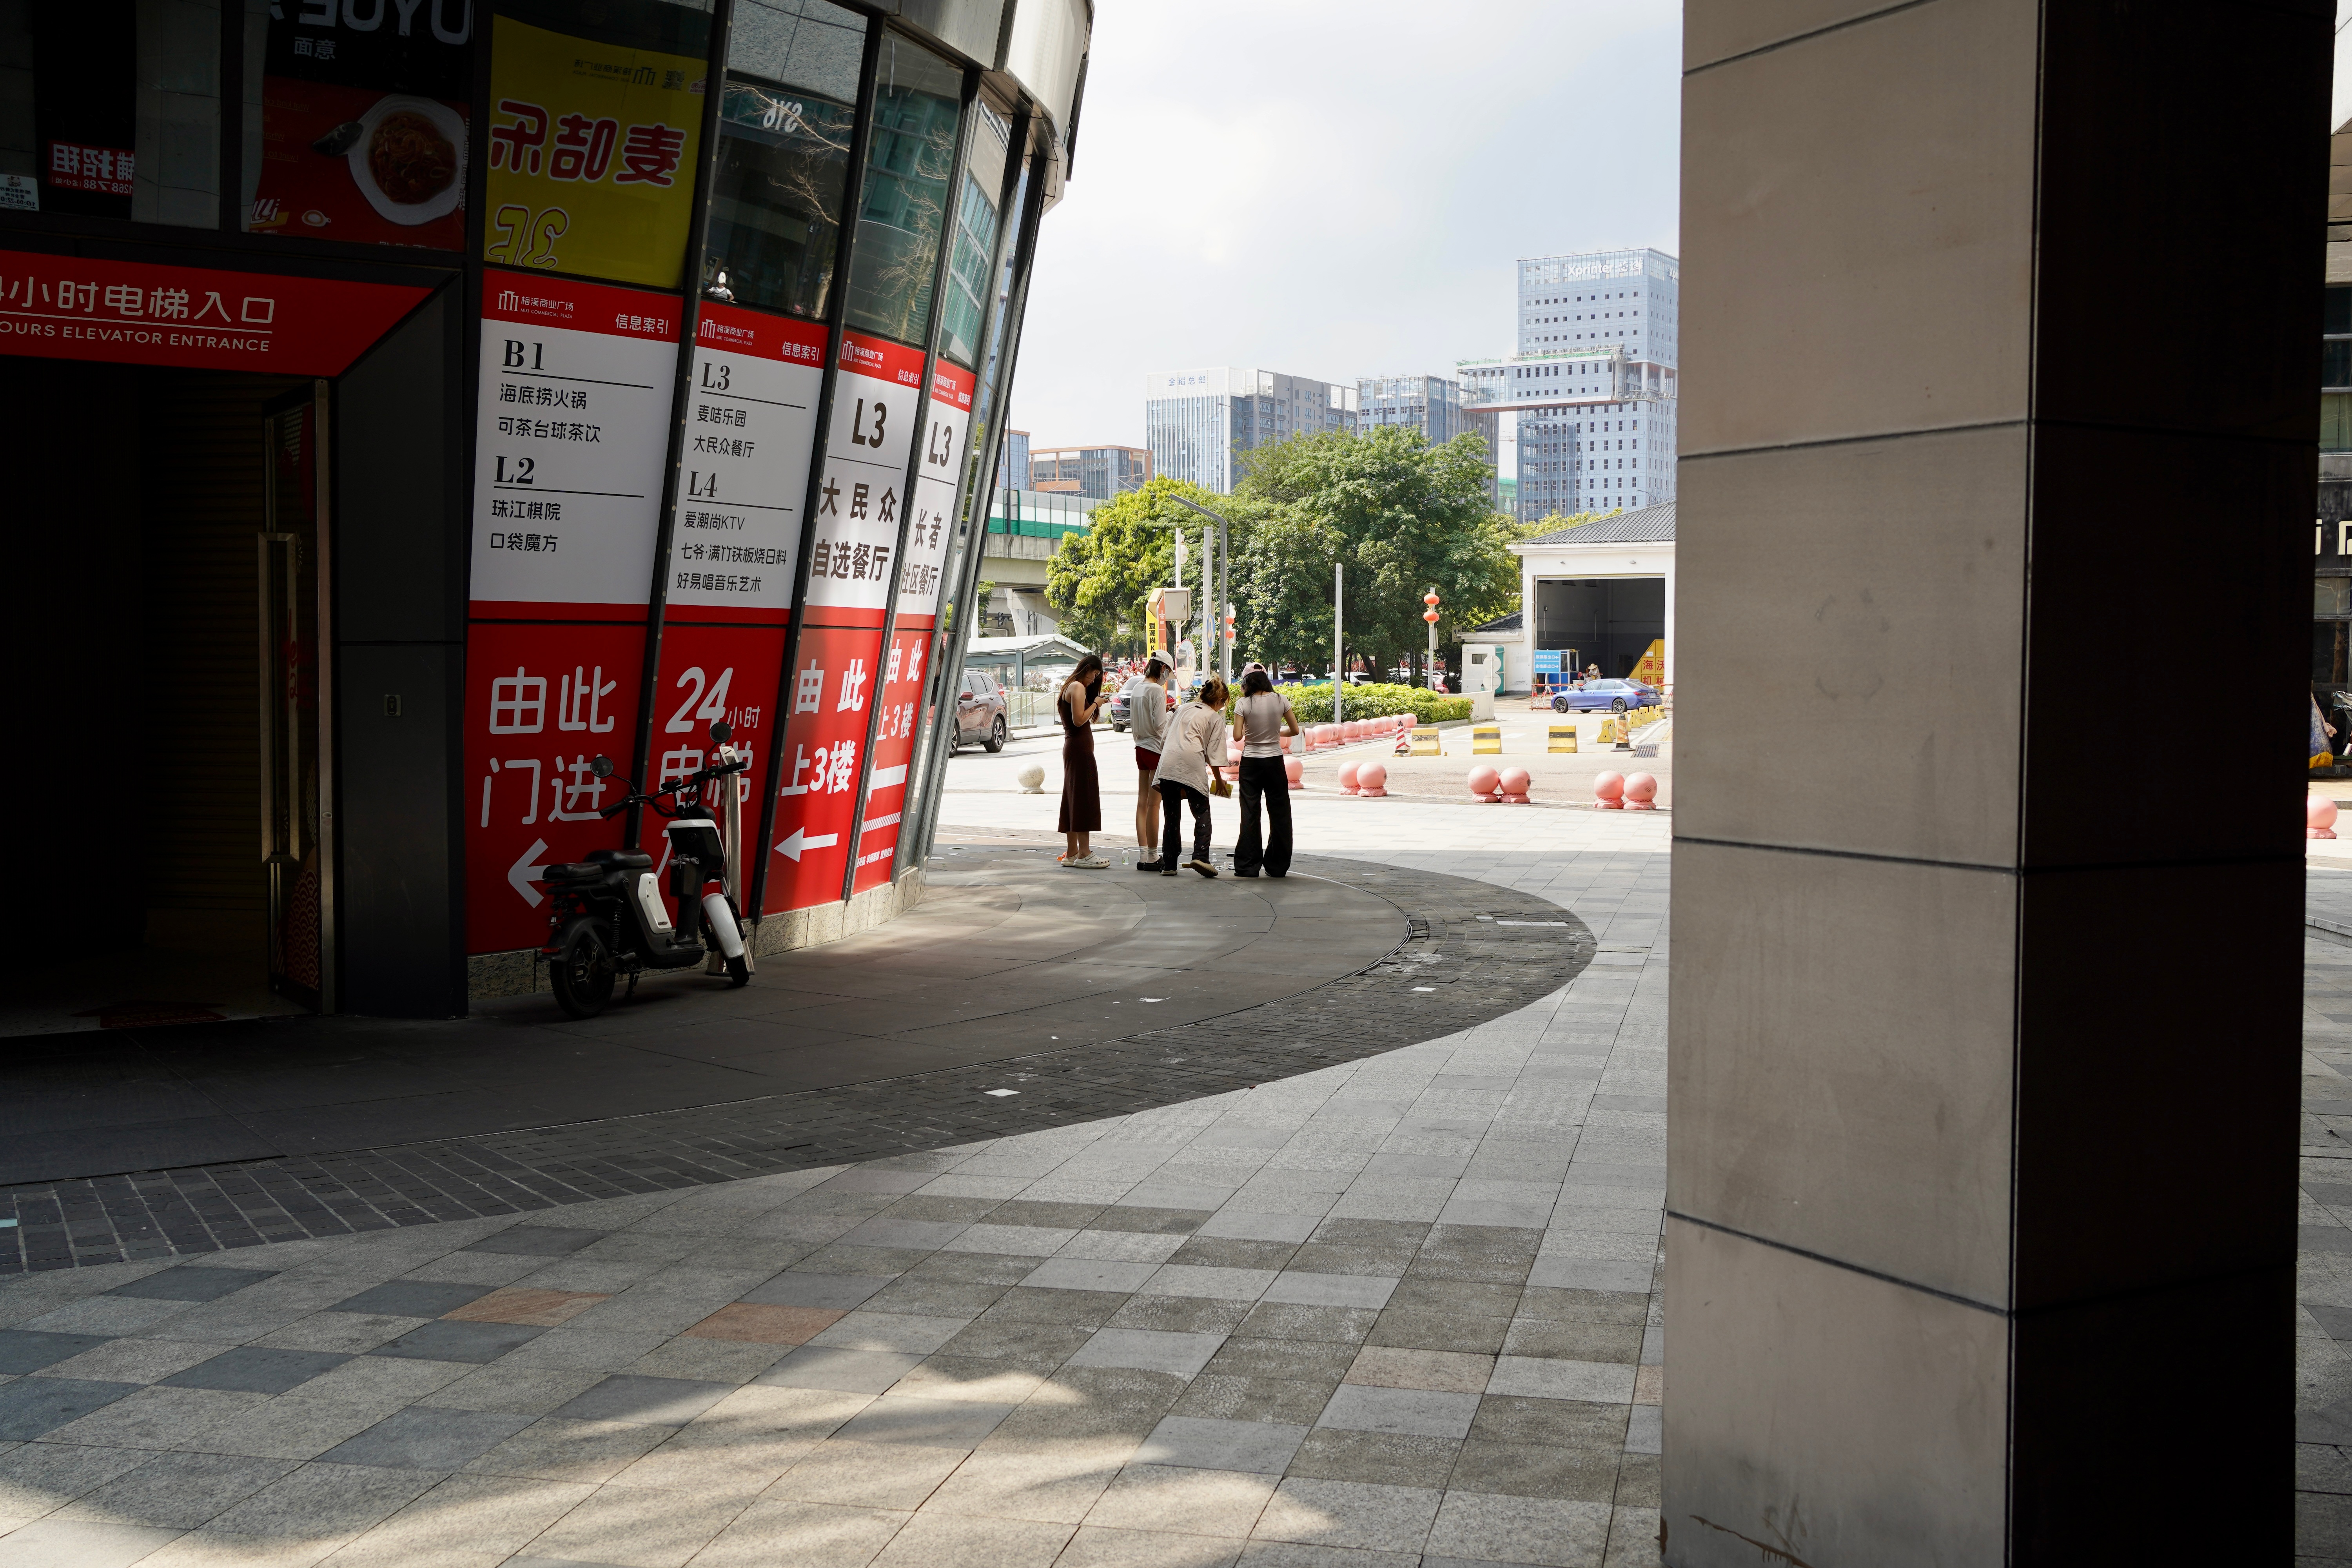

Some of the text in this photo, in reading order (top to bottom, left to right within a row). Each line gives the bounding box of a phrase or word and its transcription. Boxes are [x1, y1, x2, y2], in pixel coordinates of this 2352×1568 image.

[1568, 263, 1614, 278] Xprinter
[521, 296, 574, 311] 梅溪商业广场
[615, 313, 669, 334] 信息索引
[717, 325, 754, 339] 梅溪商业广场
[62, 326, 162, 344] ELEVATOR
[169, 334, 270, 352] ENTRANCE
[782, 341, 820, 361] 信息索引
[502, 339, 544, 370] B1
[855, 346, 884, 361] 梅溪商业广场
[701, 362, 730, 390] L3
[898, 369, 920, 385] 信息索引
[1168, 376, 1206, 386] 金稻总部
[500, 383, 586, 410] 海底捞火锅
[958, 391, 971, 406] 信息索引
[697, 405, 746, 427] 麦咭乐园
[851, 398, 887, 448] L3
[498, 416, 601, 443] 可茶台球茶饮
[693, 435, 755, 457] 大民众餐厅
[928, 421, 952, 467] L3
[494, 456, 535, 485] L2
[688, 471, 717, 497] L4
[492, 499, 561, 521] 珠江棋院
[820, 477, 897, 524] 大民众
[684, 511, 745, 530] 爱潮尚KTV
[915, 508, 942, 550] 长者
[490, 533, 558, 552] 口袋魔方
[811, 538, 890, 581] 自选餐厅
[677, 572, 762, 593] 好易唱音乐艺术
[900, 562, 938, 596] 社区餐厅
[886, 639, 923, 684] 由此
[489, 666, 617, 734] 由此
[794, 659, 867, 715] 由此
[876, 702, 914, 742] 上3楼
[781, 740, 856, 797] 上3楼
[481, 753, 607, 828] 门进
